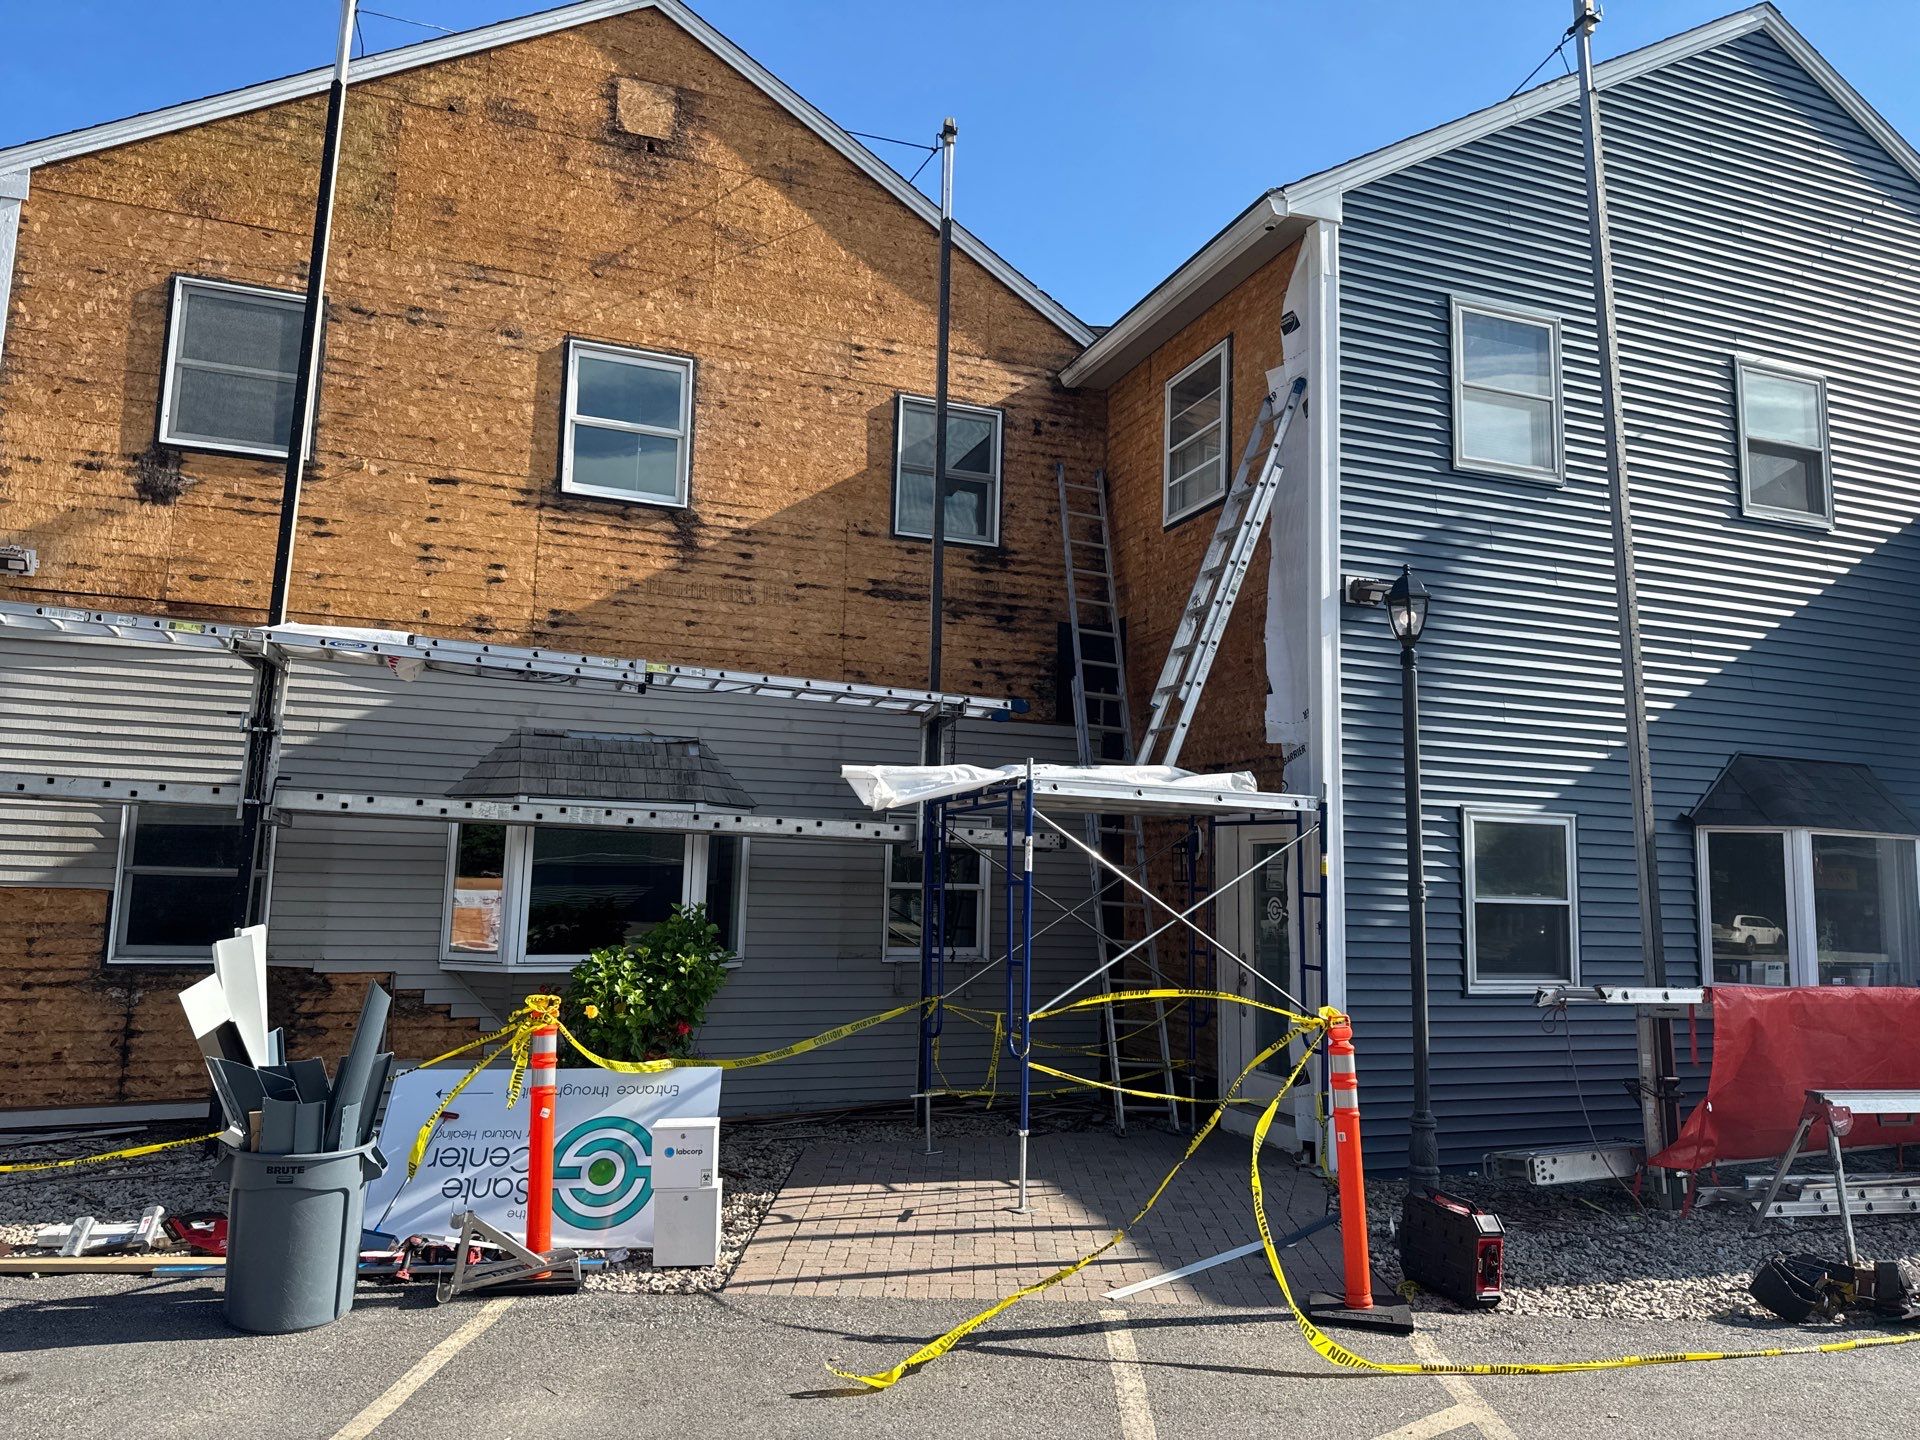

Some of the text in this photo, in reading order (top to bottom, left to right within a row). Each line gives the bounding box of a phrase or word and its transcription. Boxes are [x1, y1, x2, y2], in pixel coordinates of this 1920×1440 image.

[1283, 744, 1307, 766] BARRIER
[616, 1084, 680, 1098] Entrance
[481, 1129, 523, 1140] Natural
[675, 1147, 703, 1156] labcorp
[427, 1146, 530, 1174] Center
[266, 1165, 305, 1175] BRUTE
[441, 1177, 529, 1205] Sante
[507, 1209, 527, 1220] the
